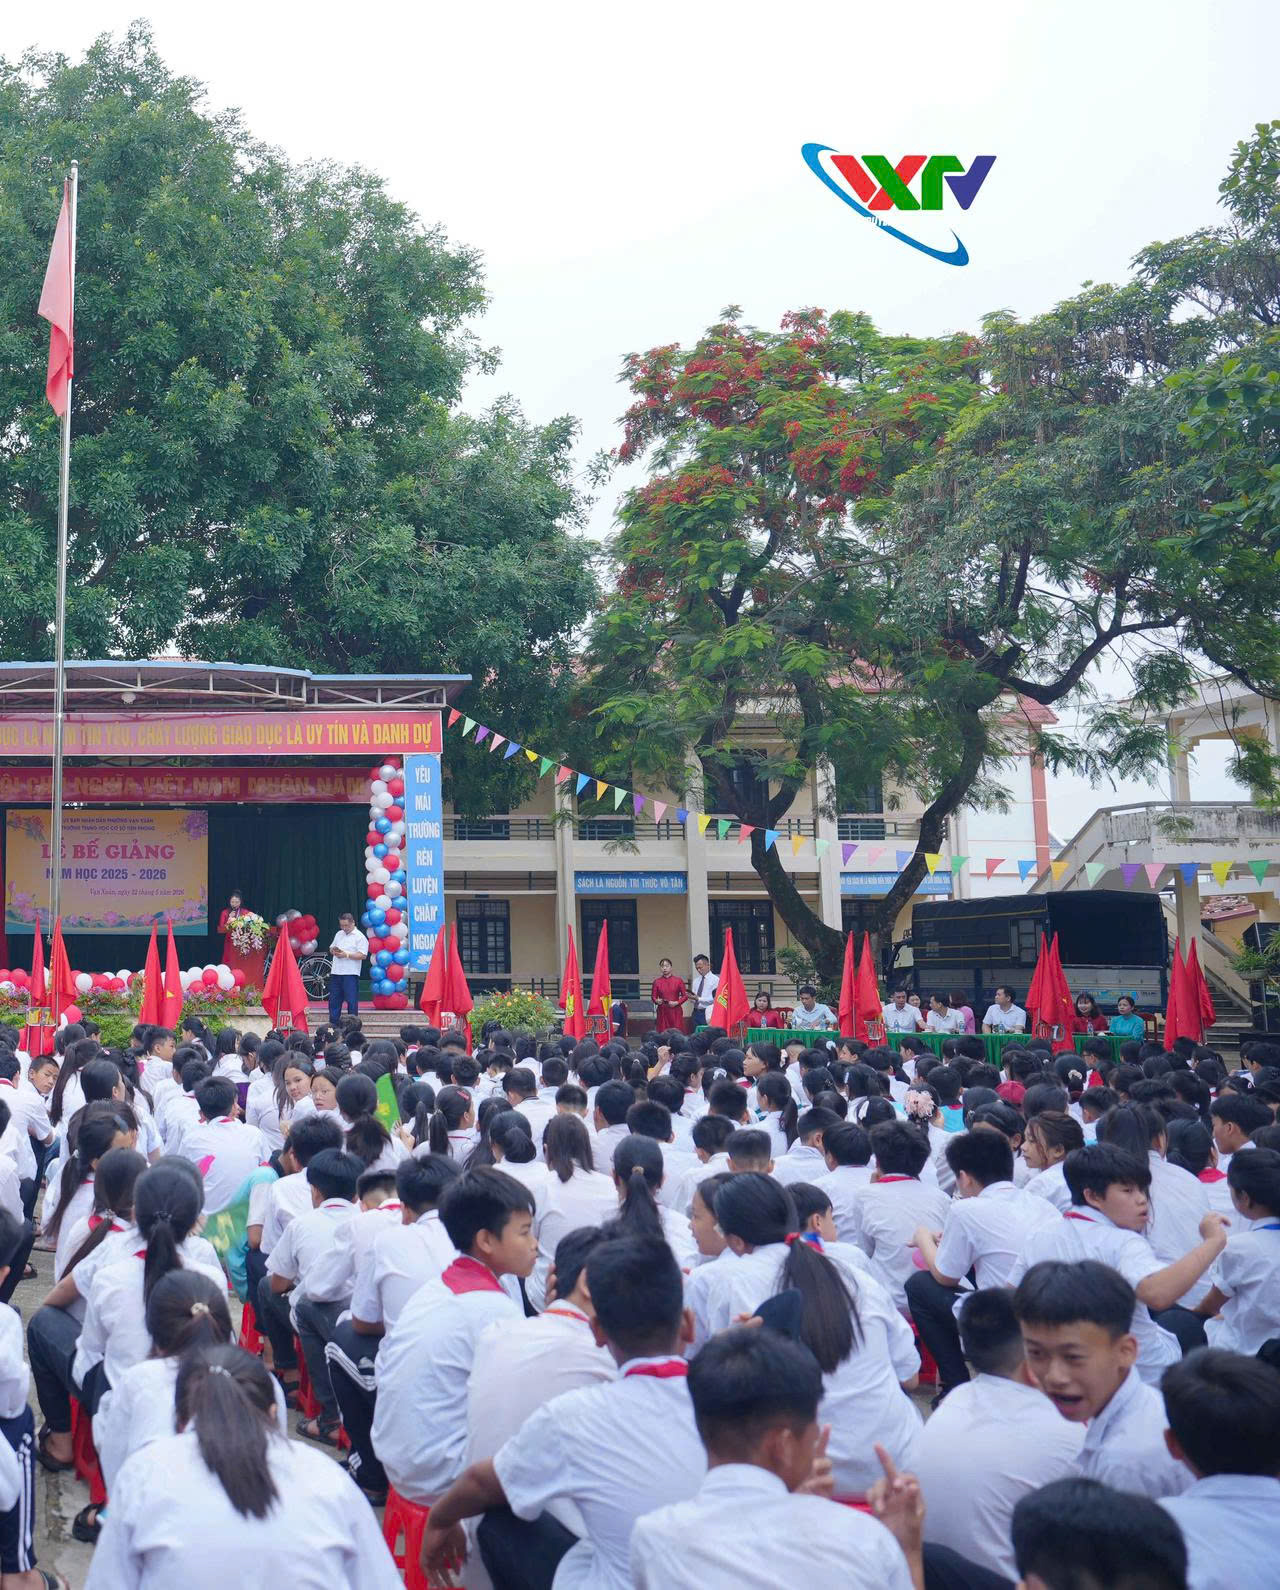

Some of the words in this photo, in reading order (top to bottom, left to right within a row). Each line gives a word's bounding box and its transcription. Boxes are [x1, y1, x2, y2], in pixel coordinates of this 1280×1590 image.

[174, 723, 217, 750] LƯỢNG
[222, 721, 252, 746] GIÁO
[256, 726, 284, 750] DỤC
[287, 721, 303, 745] LÀ
[307, 724, 323, 745] UY
[327, 720, 349, 745] TÍN
[352, 720, 370, 745] VÀ
[373, 724, 410, 745] DANH
[413, 723, 433, 749] DỰ
[415, 764, 431, 783] YÊU
[415, 794, 431, 811] MÁI
[408, 821, 440, 838] TRƯỜNG
[72, 838, 100, 860] BẾ
[105, 839, 176, 860] GIẢNG
[46, 869, 72, 880] NM
[76, 869, 98, 882] HỌC
[102, 868, 128, 880] 2025
[140, 868, 167, 880] 2026
[577, 877, 594, 888] SÁCH
[412, 876, 438, 897] LUYỆN
